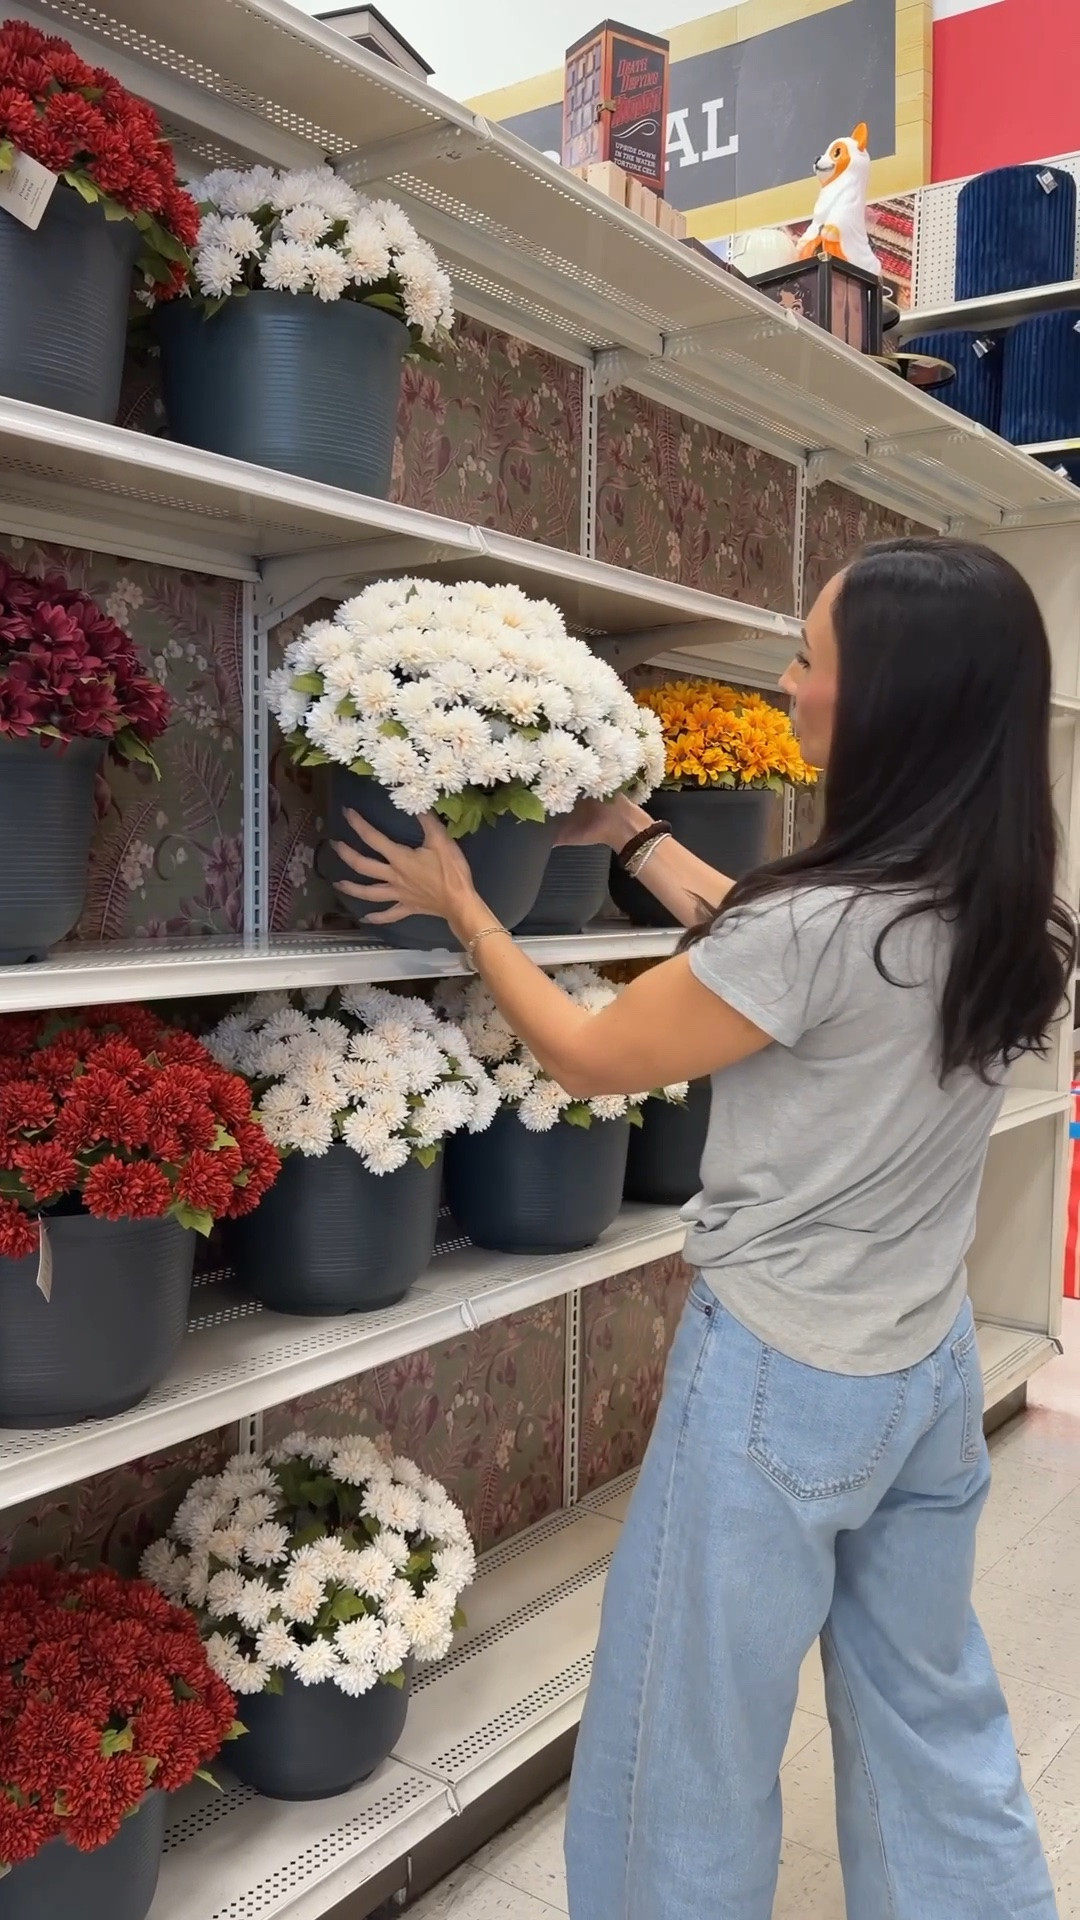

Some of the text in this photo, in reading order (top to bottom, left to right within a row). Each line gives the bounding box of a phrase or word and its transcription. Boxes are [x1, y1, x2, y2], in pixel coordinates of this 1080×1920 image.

[665, 97, 739, 171] AL
[614, 150, 656, 168] IN THE WATER
[615, 142, 657, 160] UPSIDE DOWN
[613, 158, 657, 176] TORTURE CELL
